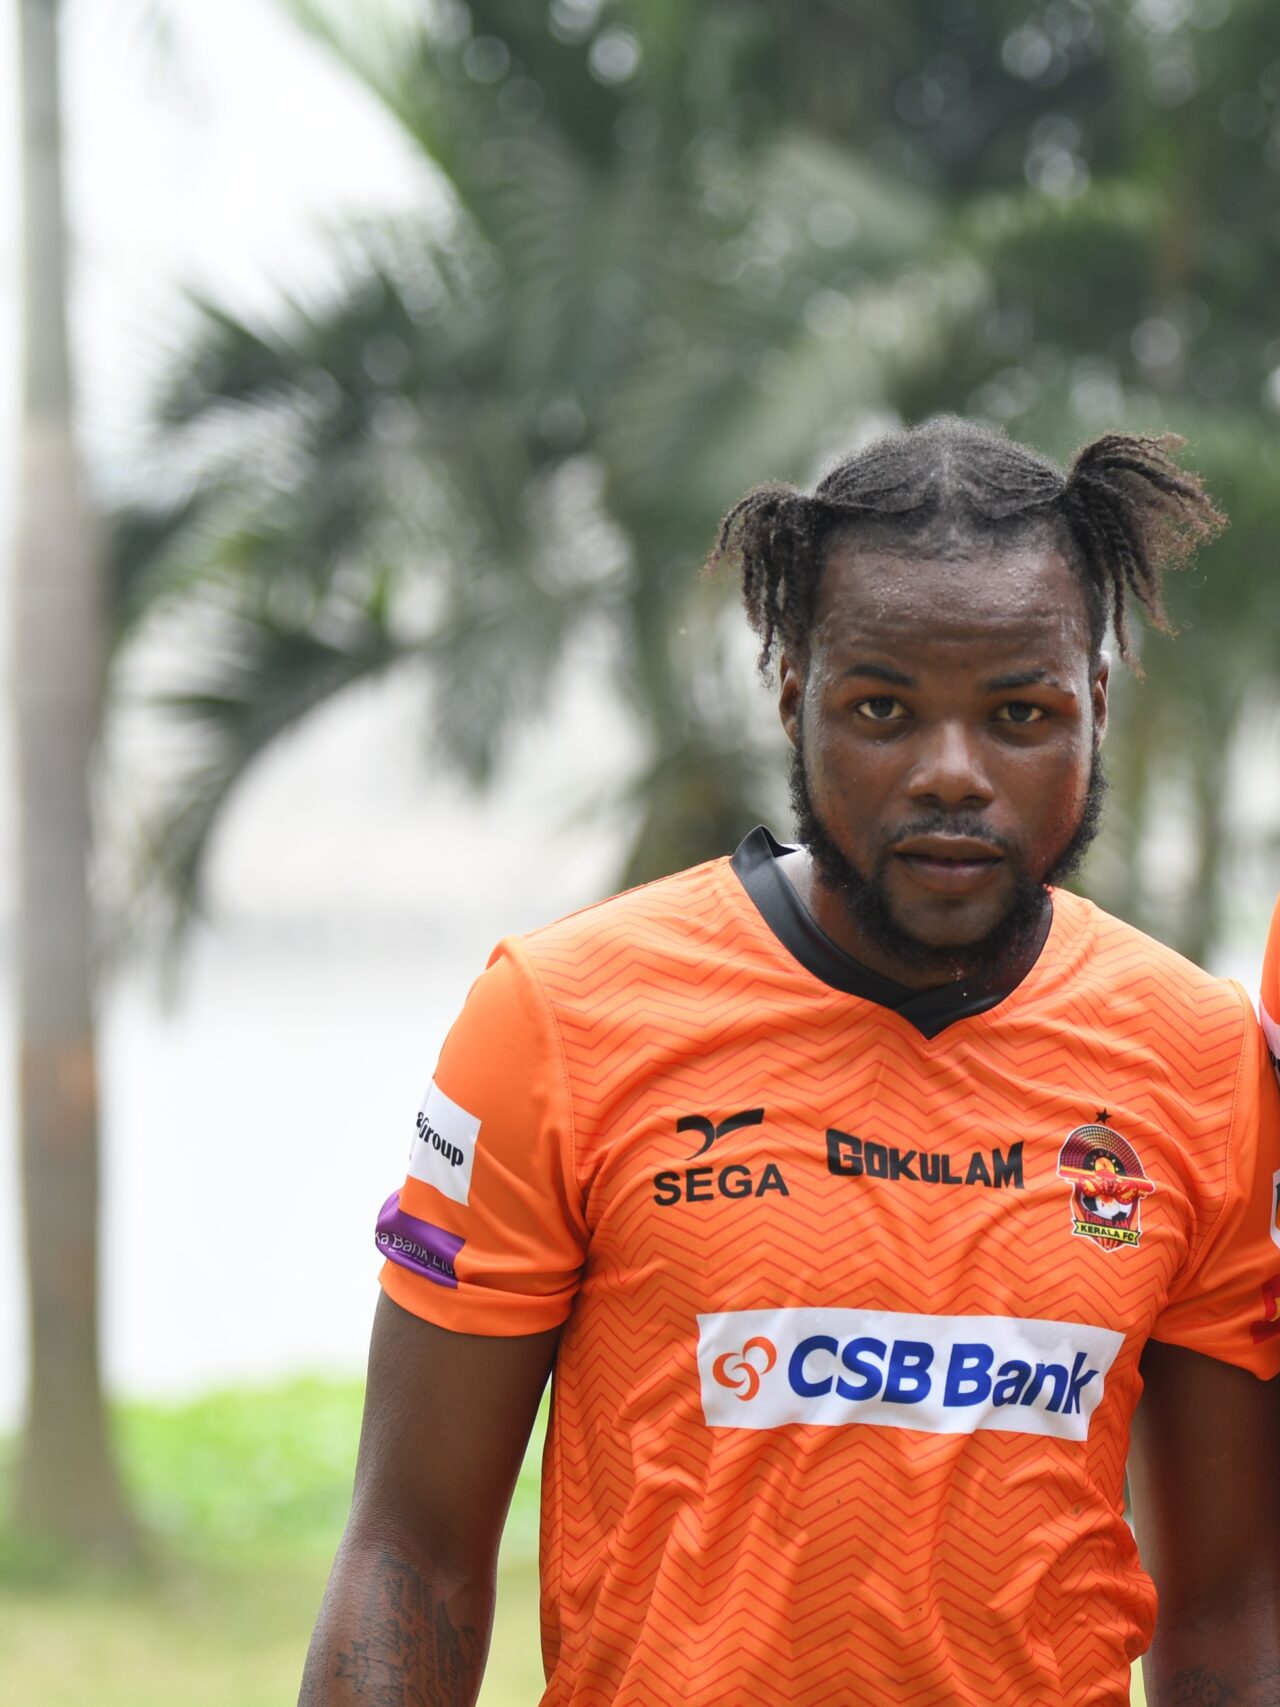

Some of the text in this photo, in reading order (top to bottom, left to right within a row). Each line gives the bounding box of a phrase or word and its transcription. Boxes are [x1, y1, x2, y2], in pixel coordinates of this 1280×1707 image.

[826, 1128, 1024, 1189] GOKULAM
[653, 1164, 789, 1206] SEGA
[392, 1233, 428, 1261] Bank
[1080, 1224, 1134, 1241] KERALA FC
[788, 1335, 1099, 1414] CSB Bank
